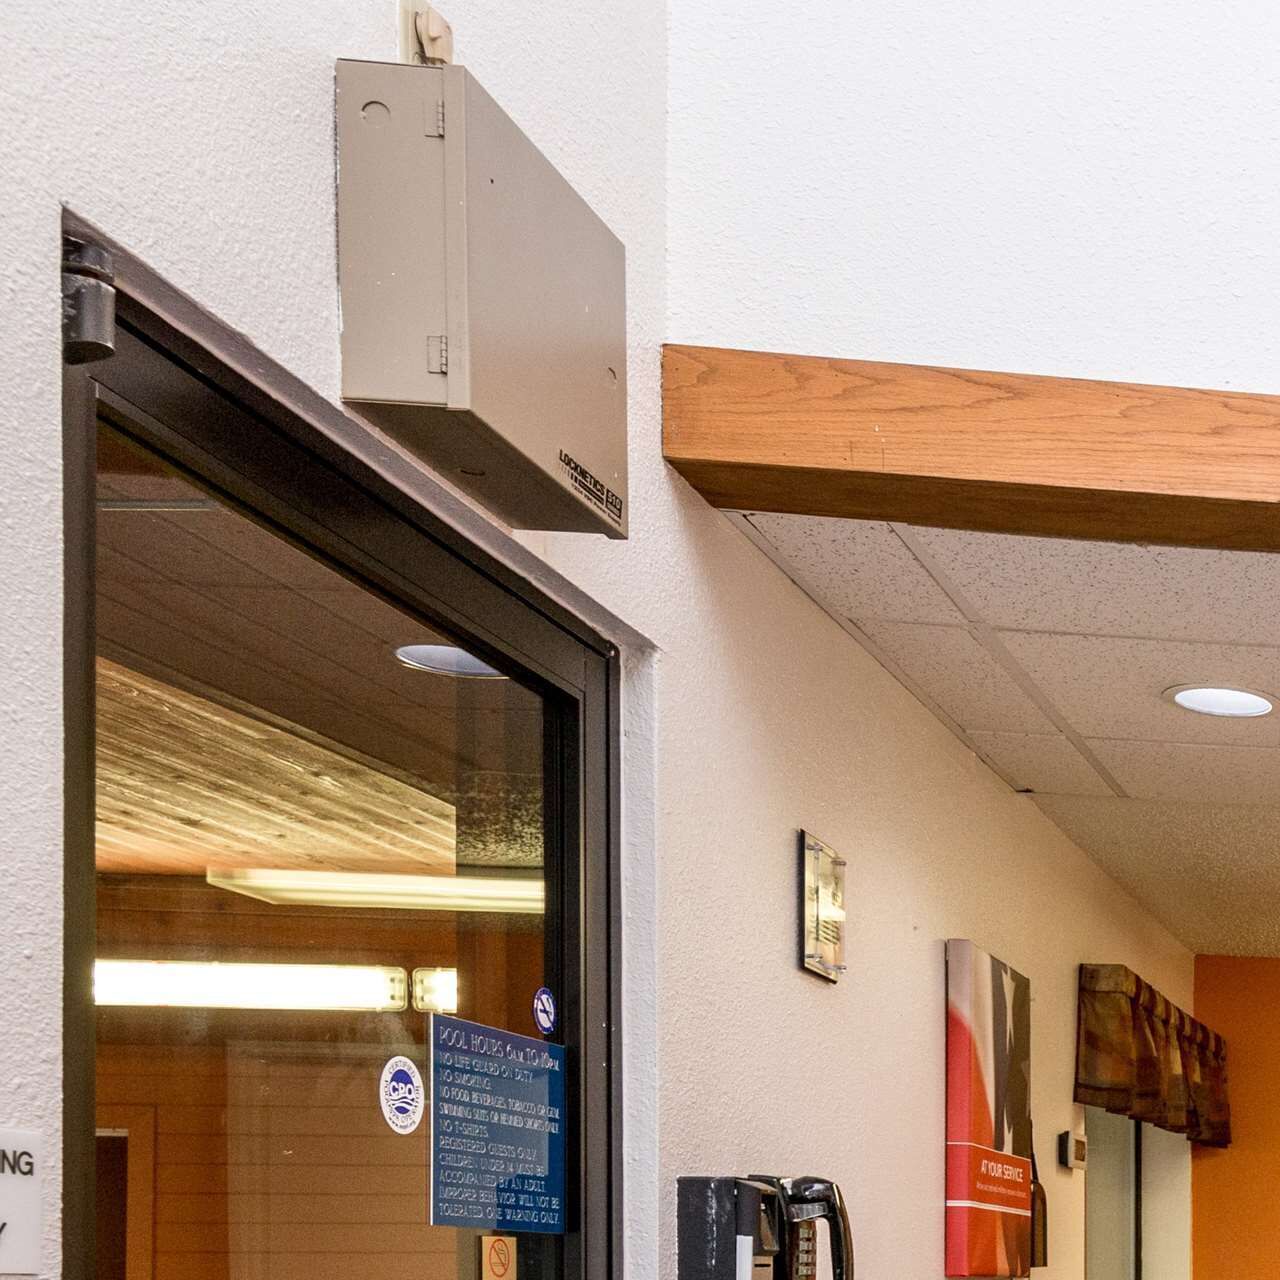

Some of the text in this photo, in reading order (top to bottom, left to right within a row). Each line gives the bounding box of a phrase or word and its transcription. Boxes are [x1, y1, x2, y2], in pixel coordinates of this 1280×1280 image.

[560, 448, 606, 496] LOCKNETICS
[440, 1026, 468, 1050] POOL
[471, 1033, 504, 1058] HOURS
[526, 1047, 538, 1066] TO
[440, 1052, 452, 1065] NO
[454, 1055, 470, 1070] LIFE
[472, 1059, 500, 1076] GUARD
[501, 1065, 514, 1079] ON
[440, 1068, 452, 1082] NO
[390, 1081, 414, 1100] CPO
[440, 1086, 450, 1098] NO
[440, 1118, 452, 1132] NO
[440, 1135, 486, 1154] REGISTERED
[488, 1143, 516, 1158] GUESTS
[440, 1152, 479, 1169] CHILDREN
[480, 1158, 504, 1172] UNDER
[988, 1161, 1002, 1178] YOUR
[1003, 1164, 1024, 1182] SERVICE
[440, 1169, 497, 1188] ACCOMPANIED
[499, 1176, 508, 1188] BY
[510, 1177, 522, 1190] AN
[440, 1186, 560, 1210] IMPROPER BEHAVIOR WILL NOT BE
[486, 1206, 503, 1220] ONE
[504, 1208, 538, 1222] WARNING
